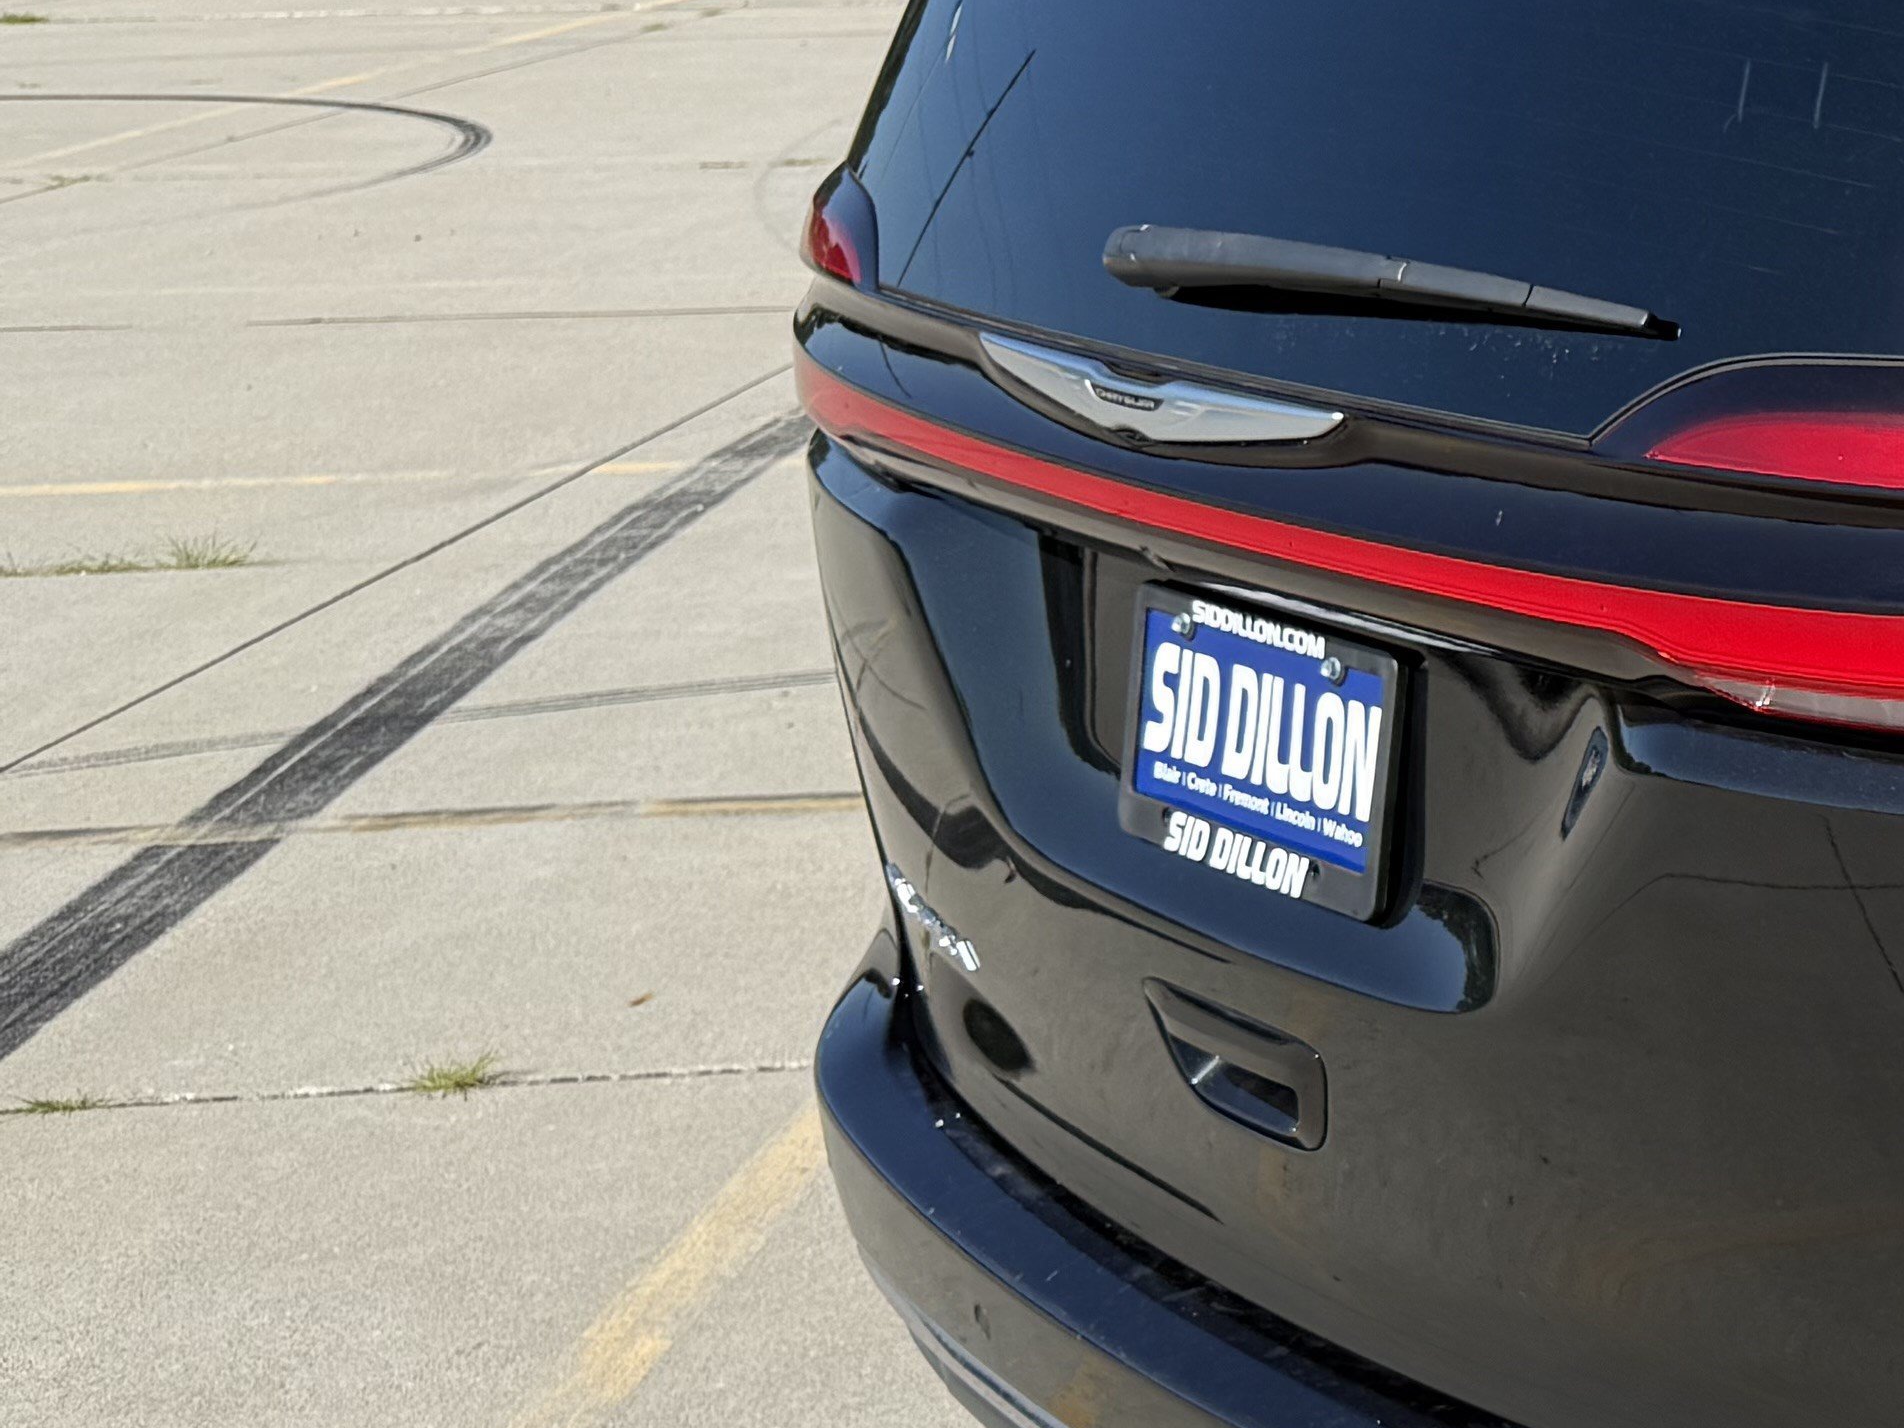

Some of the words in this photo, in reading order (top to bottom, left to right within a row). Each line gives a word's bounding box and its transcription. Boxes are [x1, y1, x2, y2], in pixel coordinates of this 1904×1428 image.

[1191, 599, 1326, 660] SIDDILLON.COM
[1143, 641, 1221, 768] SID
[1221, 663, 1383, 823] DILLON
[1222, 783, 1270, 816] Fremont
[1275, 801, 1317, 831] Lincoln
[1322, 817, 1364, 848] Wahoo
[1164, 811, 1212, 862] SID
[1209, 827, 1310, 899] DILLON
